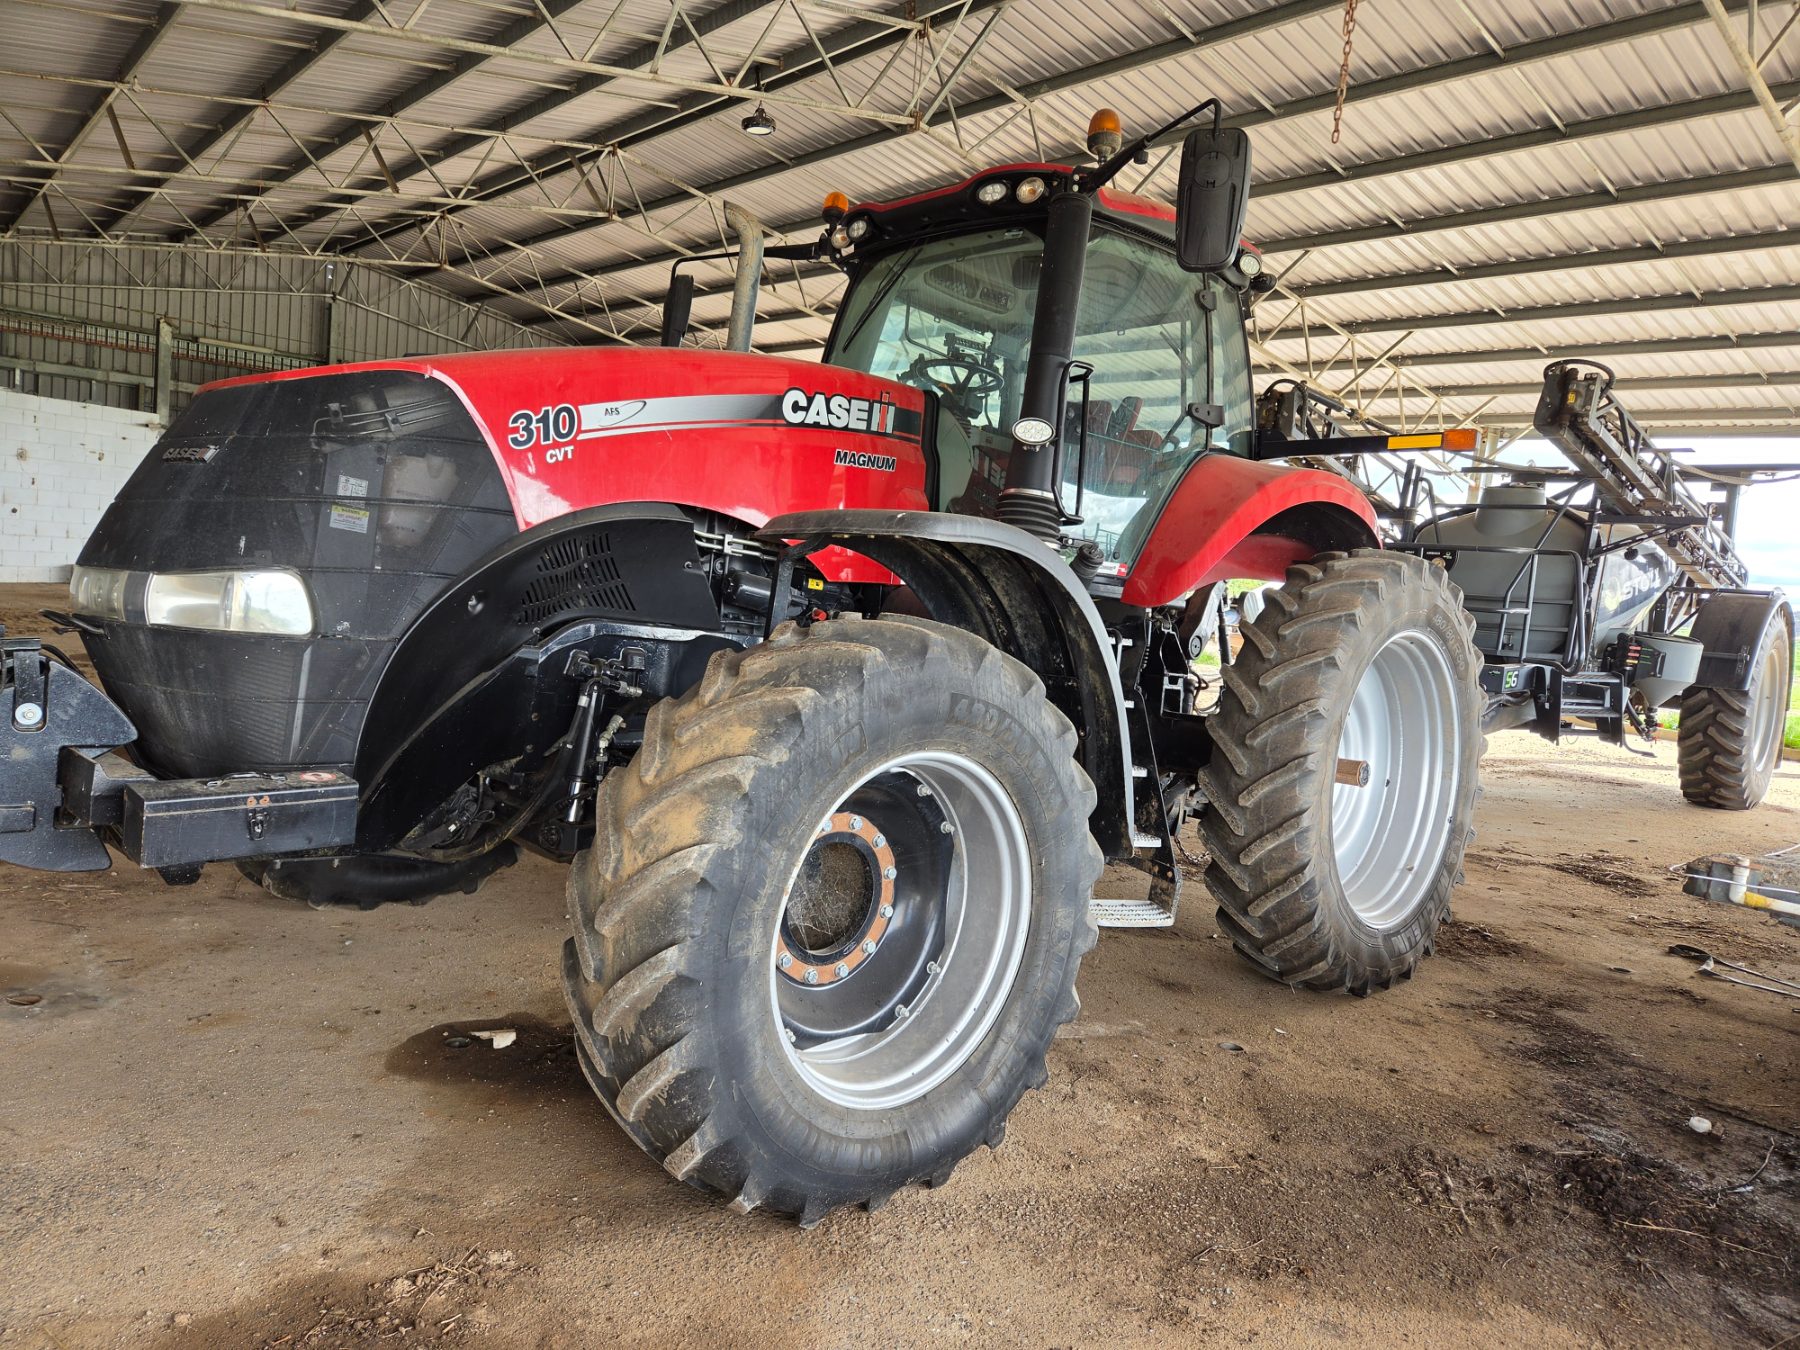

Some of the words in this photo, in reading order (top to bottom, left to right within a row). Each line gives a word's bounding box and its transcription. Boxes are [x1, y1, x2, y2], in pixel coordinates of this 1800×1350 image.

[604, 407, 620, 416] AFS
[508, 403, 577, 449] 310
[545, 445, 575, 464] CVT
[834, 449, 897, 472] MAGNUM
